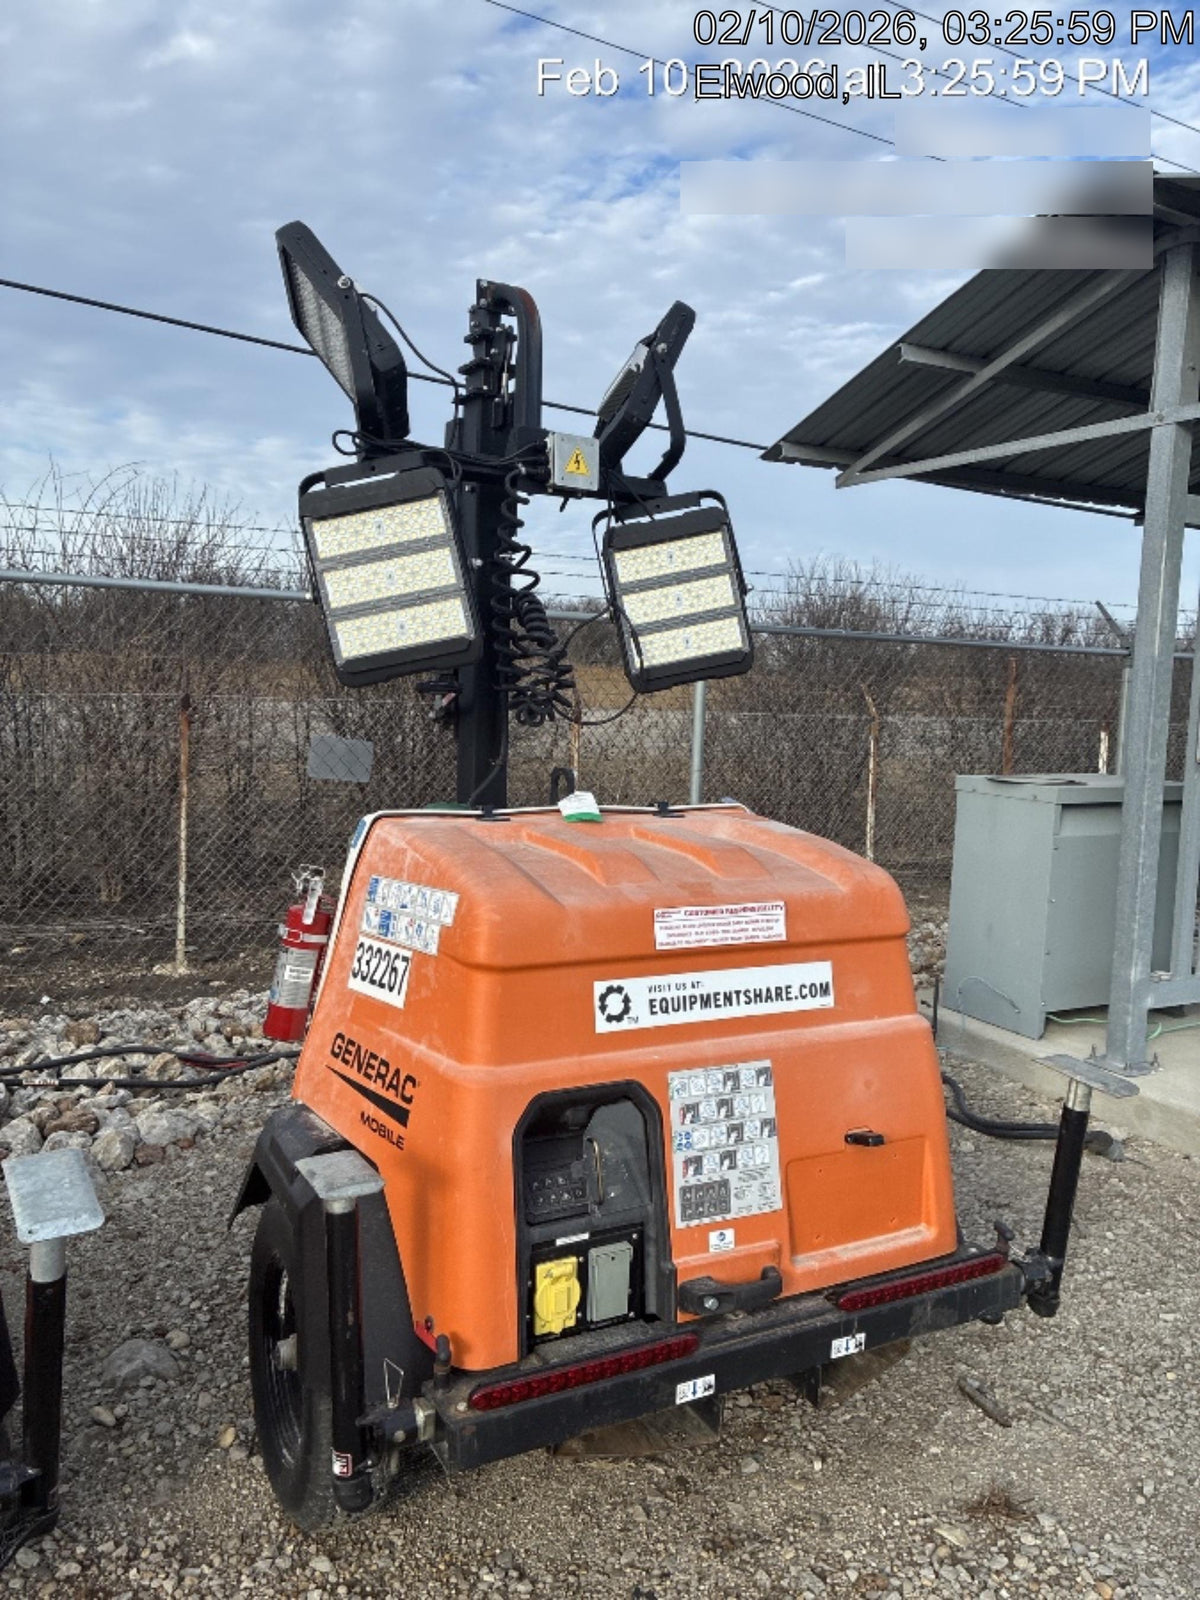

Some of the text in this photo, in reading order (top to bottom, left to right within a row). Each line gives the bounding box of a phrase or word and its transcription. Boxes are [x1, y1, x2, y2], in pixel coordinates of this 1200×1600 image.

[351, 941, 410, 997] 332267
[648, 983, 672, 993] VISIT
[675, 982, 687, 991] US
[648, 981, 832, 1015] EQUIPMENTSHARE.COM
[330, 1032, 417, 1105] GENERAC
[360, 1110, 405, 1151] MOBILE
